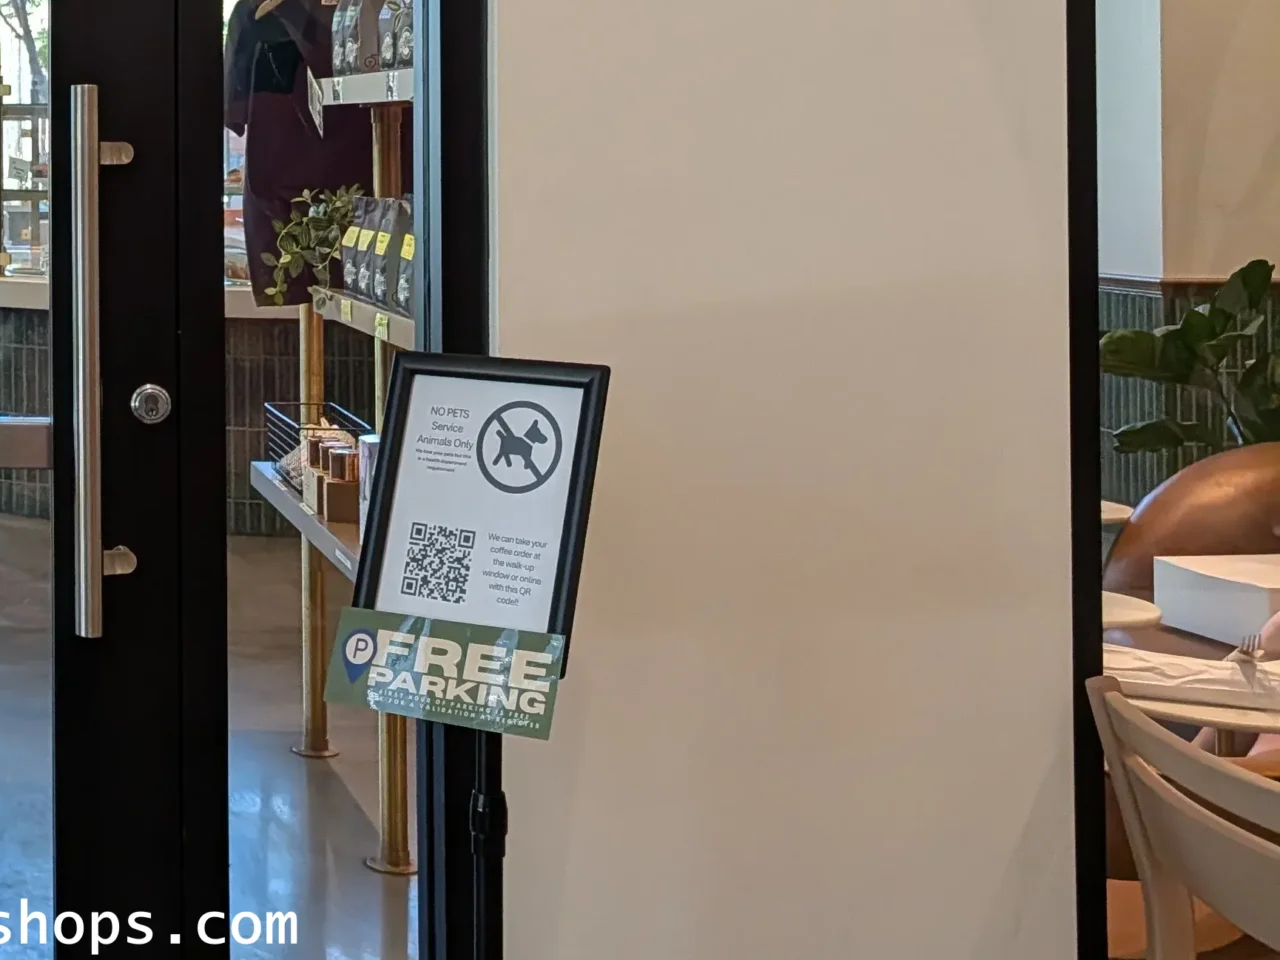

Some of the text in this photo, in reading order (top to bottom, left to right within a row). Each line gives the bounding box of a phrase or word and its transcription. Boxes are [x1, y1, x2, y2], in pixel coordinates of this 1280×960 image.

[431, 406, 469, 418] NO PETS
[432, 421, 463, 433] Service
[417, 434, 474, 451] Animals Only
[488, 532, 500, 541] We
[515, 537, 530, 546] take
[490, 546, 541, 560] coffee order at
[493, 558, 534, 572] the walk-up
[482, 569, 510, 579] window
[519, 575, 542, 585] online
[488, 583, 531, 596] with this QR
[372, 629, 553, 693] FREE
[367, 666, 546, 715] PARKING
[378, 688, 404, 700] FIRST
[408, 693, 433, 705] HOUR
[450, 700, 491, 715] PARKING
[494, 708, 505, 716] IS
[387, 697, 405, 706] FOR
[419, 703, 476, 718] VALIDATION
[479, 713, 491, 722] AT
